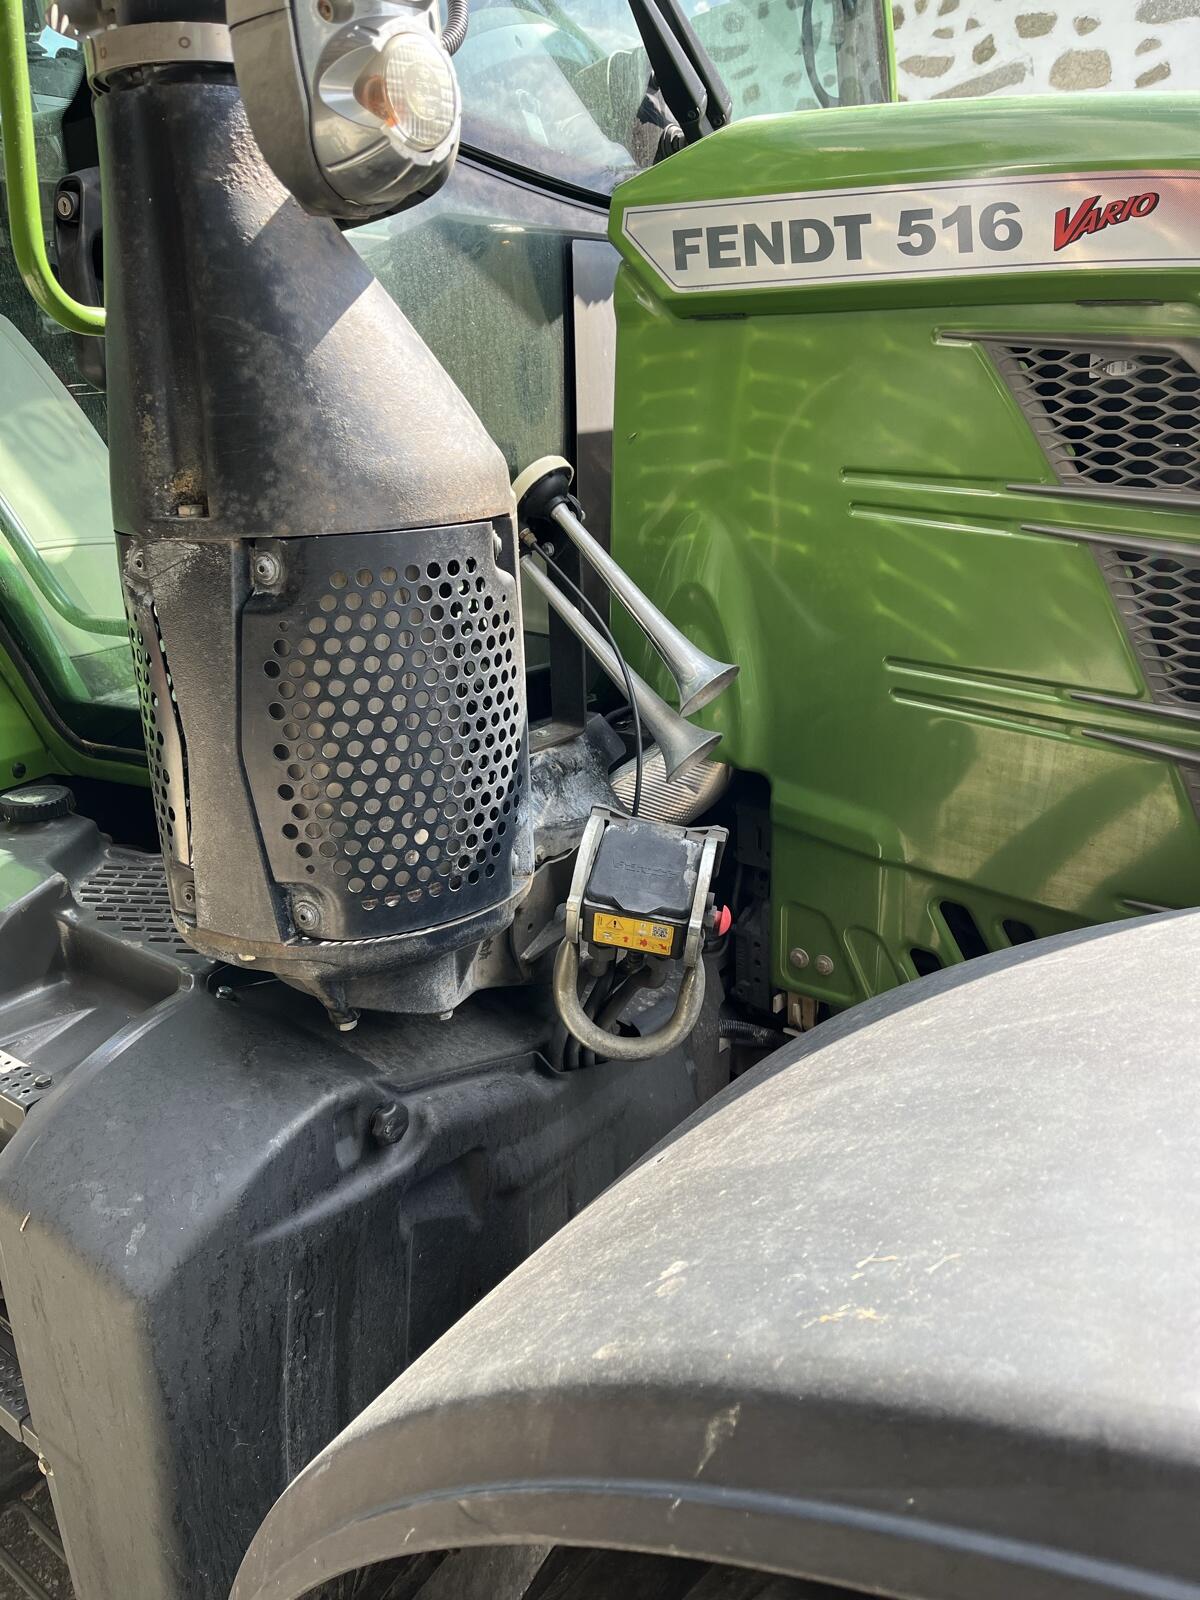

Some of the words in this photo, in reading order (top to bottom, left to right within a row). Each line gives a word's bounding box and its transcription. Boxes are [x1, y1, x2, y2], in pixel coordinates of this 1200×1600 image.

[672, 213, 872, 271] FENDT
[896, 201, 1024, 256] 516
[1054, 192, 1160, 251] VARIO
